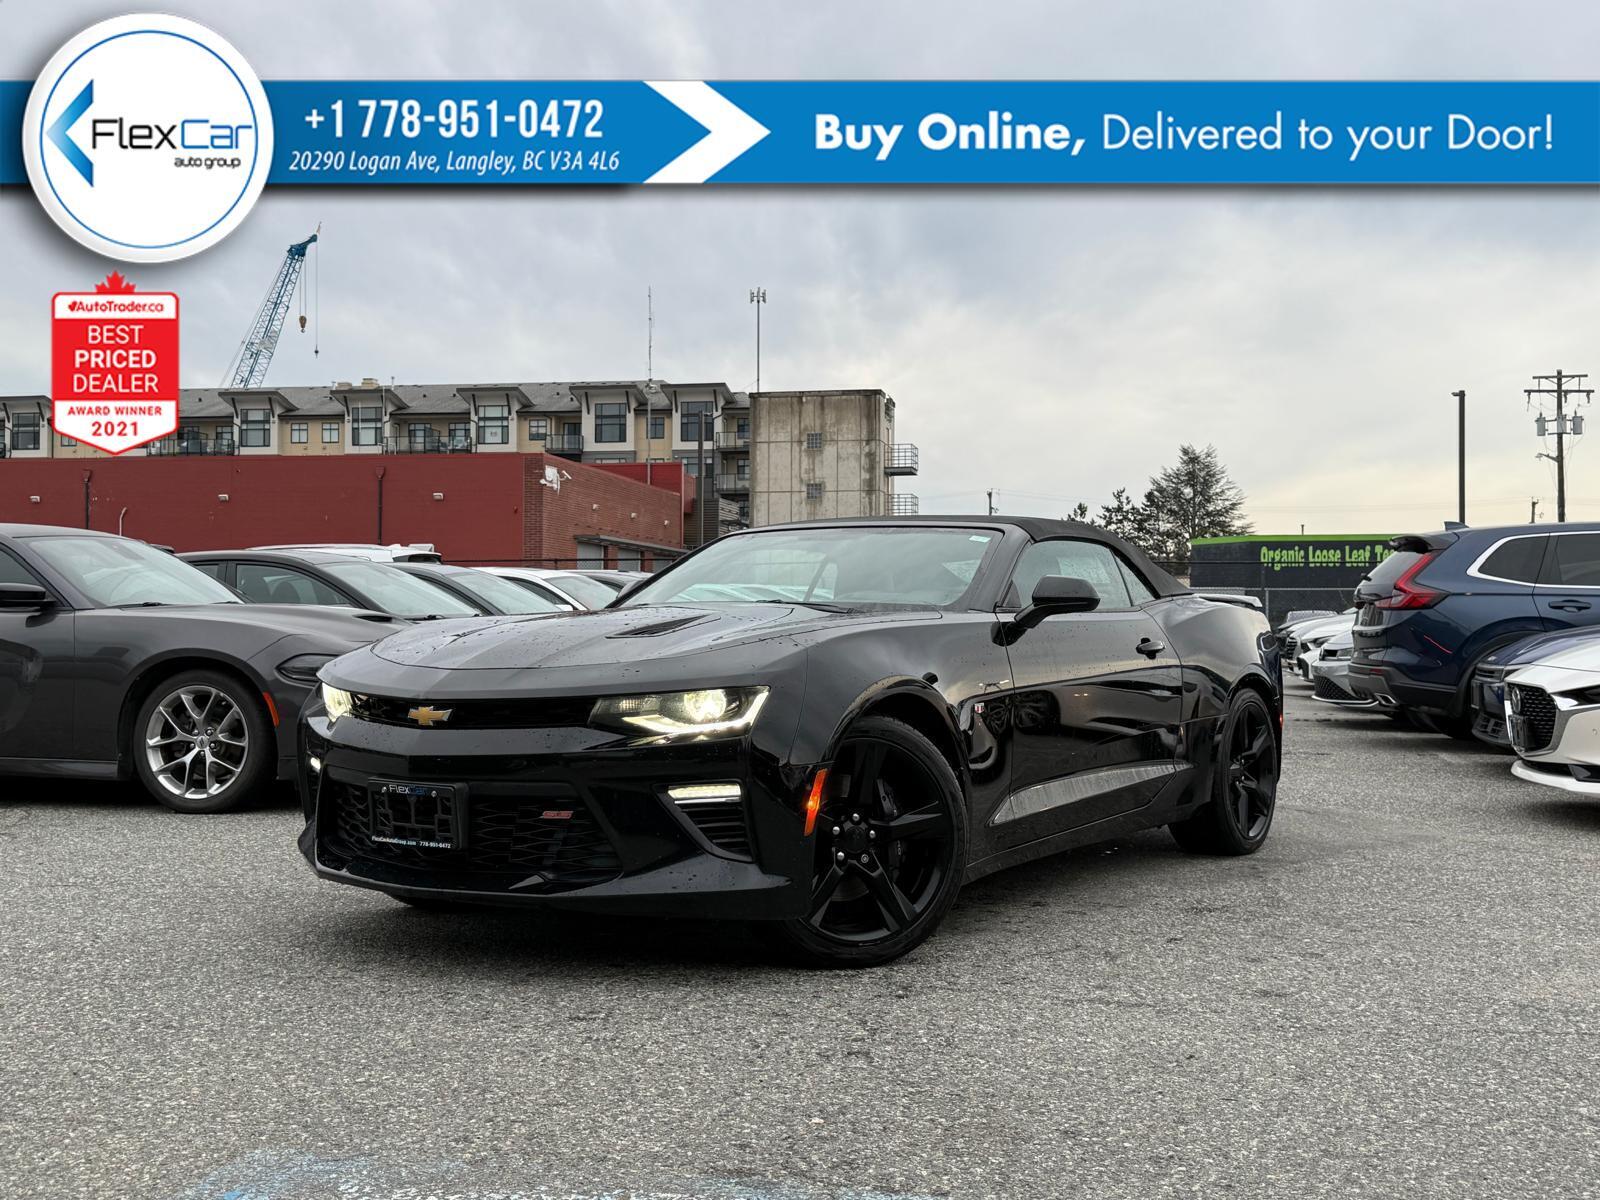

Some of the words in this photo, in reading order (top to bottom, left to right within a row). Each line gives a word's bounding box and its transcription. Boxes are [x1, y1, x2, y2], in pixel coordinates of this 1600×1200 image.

[1260, 546, 1304, 571] Organic
[1308, 545, 1341, 567] Loose
[1345, 545, 1371, 567] Leaf
